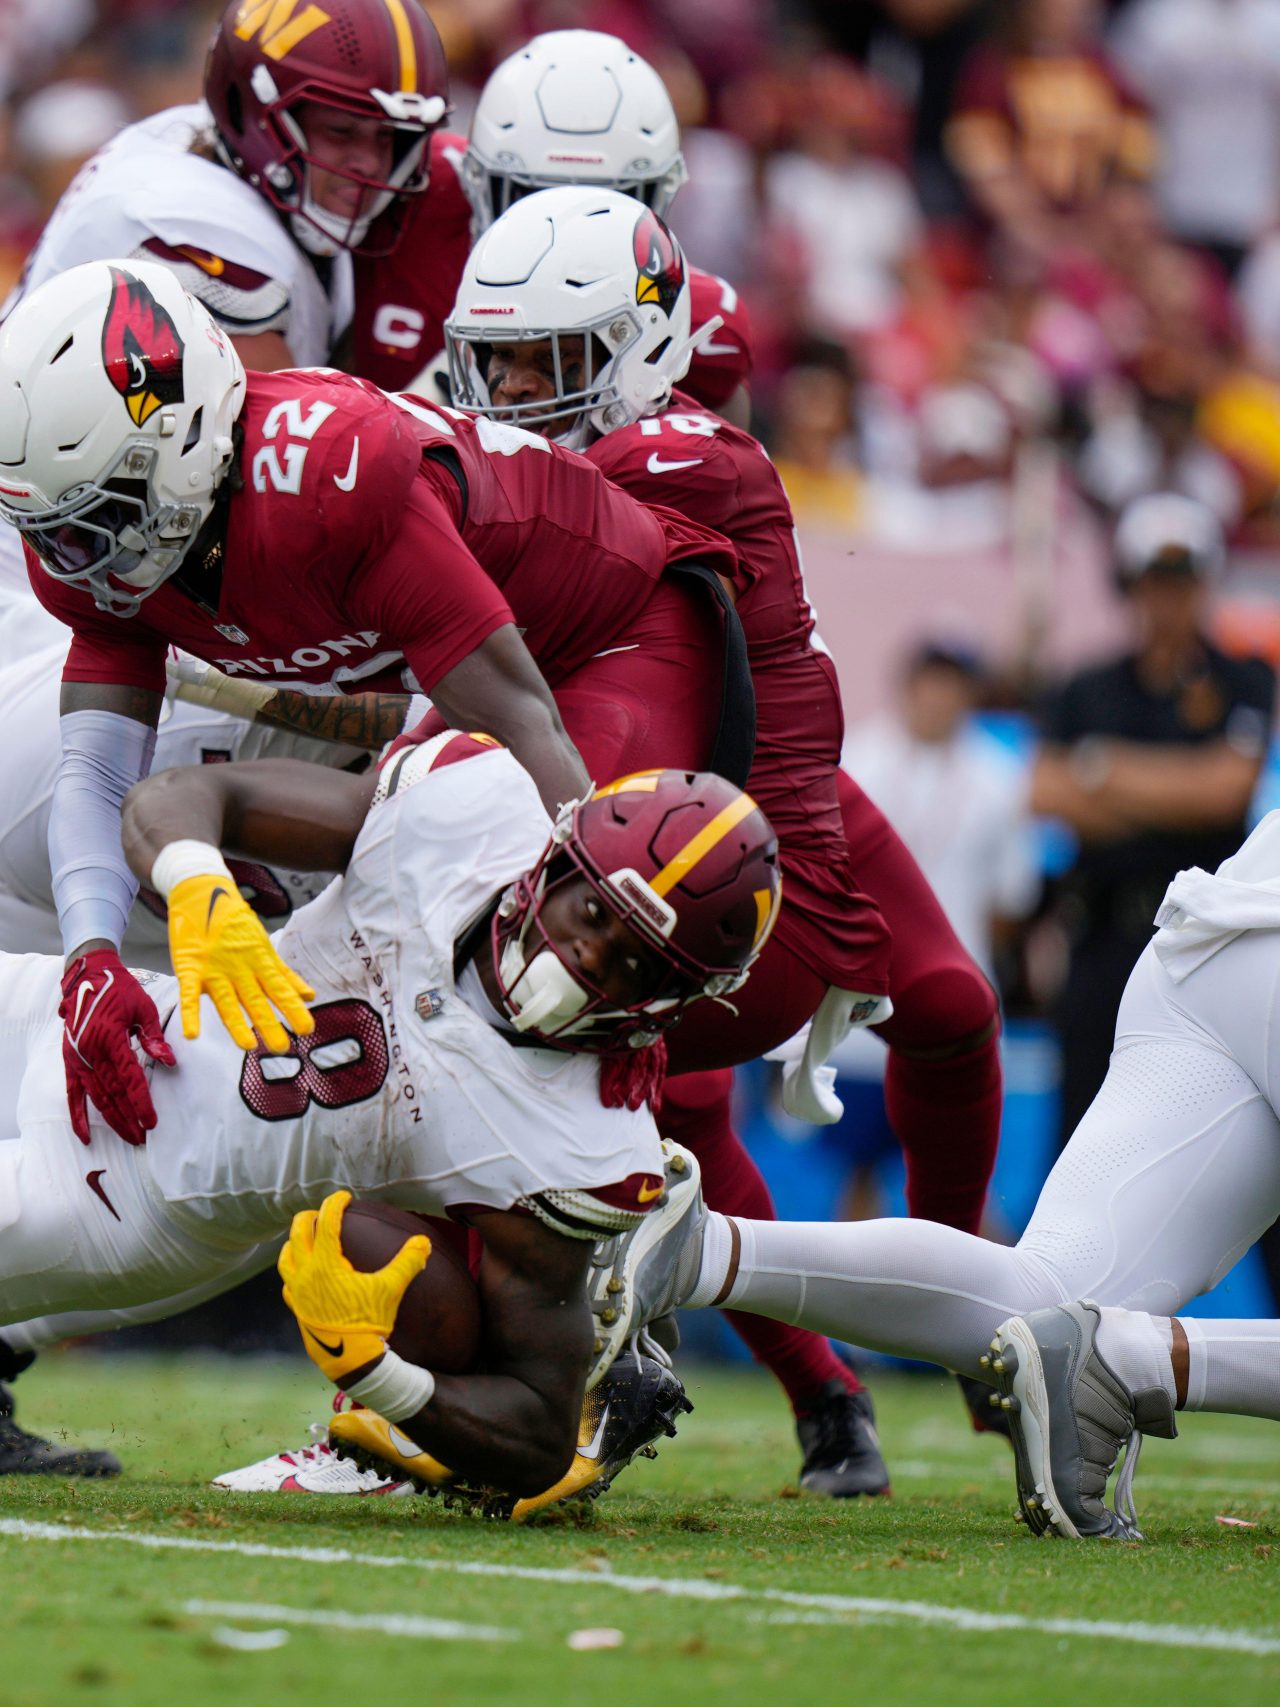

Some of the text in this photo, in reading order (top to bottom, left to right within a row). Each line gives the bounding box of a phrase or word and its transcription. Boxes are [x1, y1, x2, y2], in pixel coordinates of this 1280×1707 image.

[373, 304, 425, 350] C
[252, 399, 337, 496] 22
[213, 630, 381, 675] RIZONA
[239, 997, 390, 1123] 8
